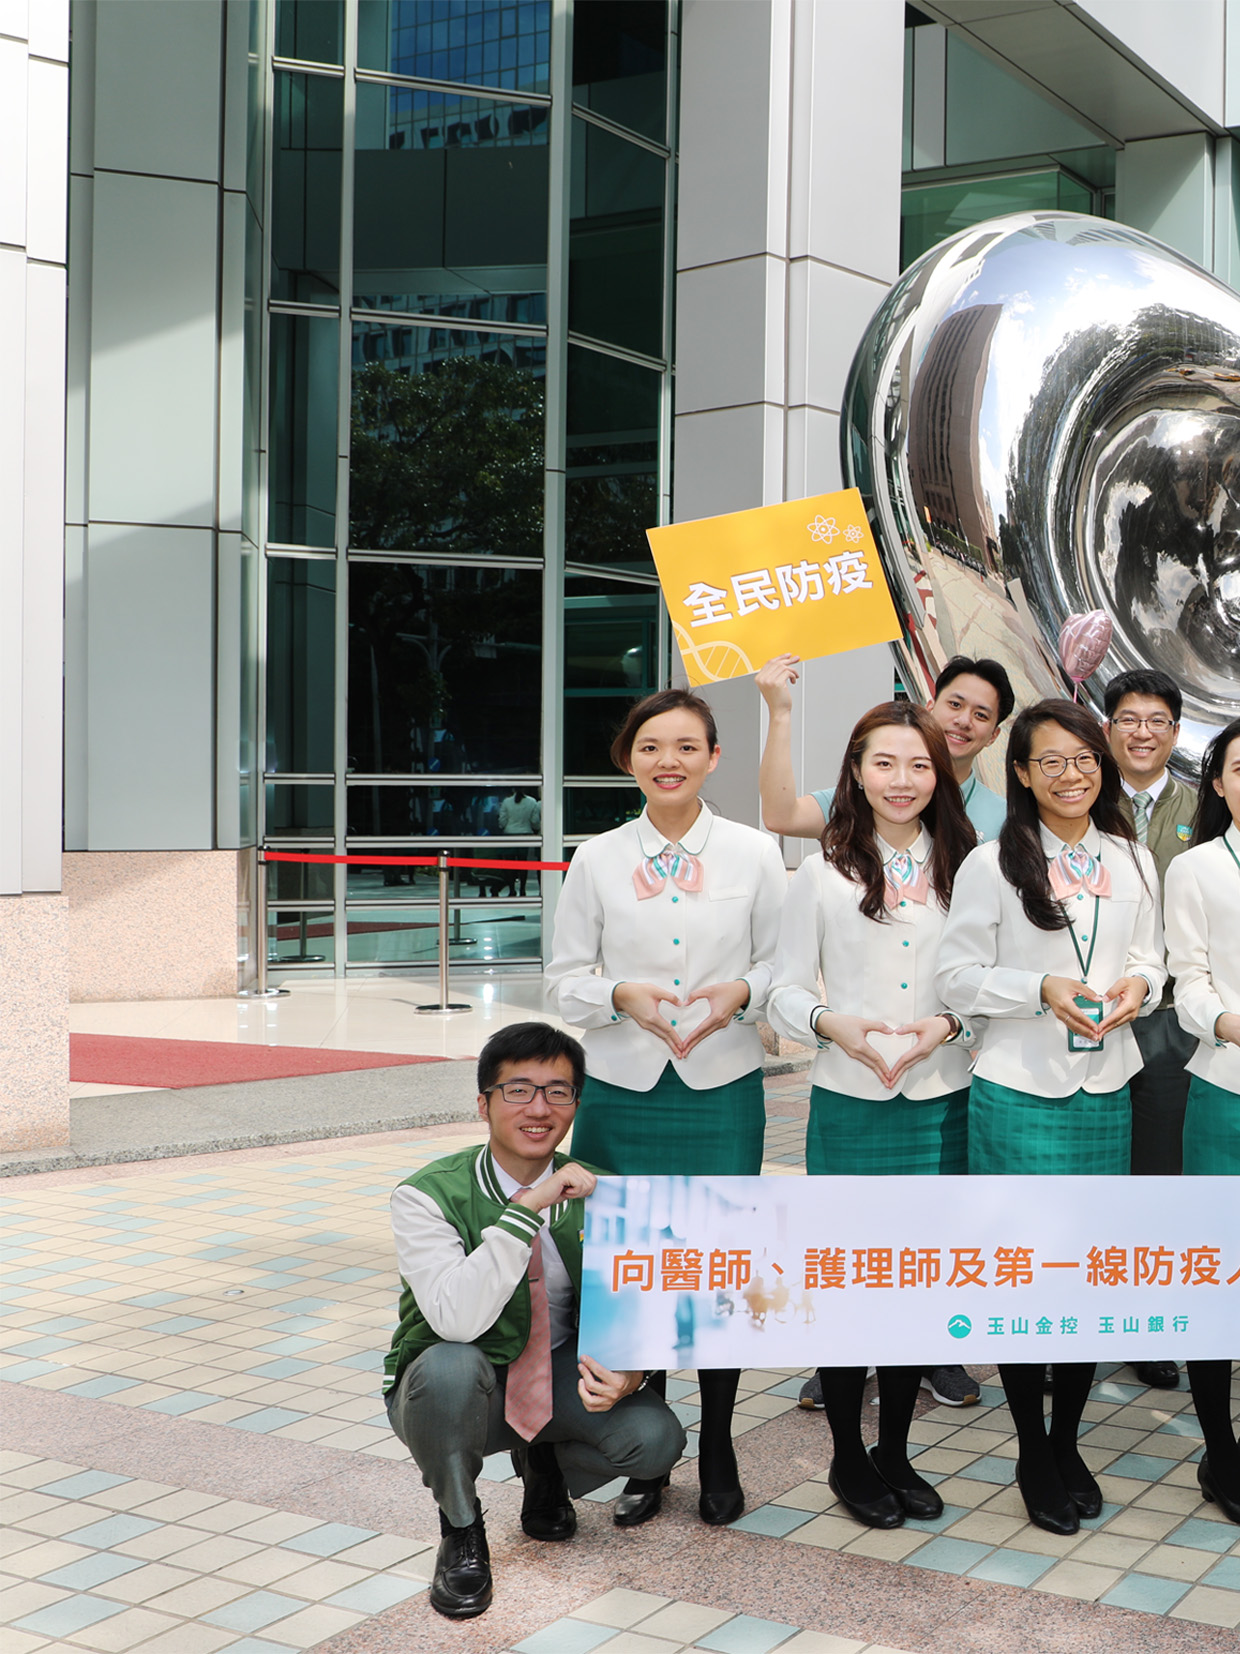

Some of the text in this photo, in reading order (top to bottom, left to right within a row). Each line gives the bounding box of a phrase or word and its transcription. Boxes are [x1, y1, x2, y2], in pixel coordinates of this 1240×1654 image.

[682, 549, 873, 628] 全民防疫
[986, 1315, 1190, 1336] 玉山金控 玉山銀行
